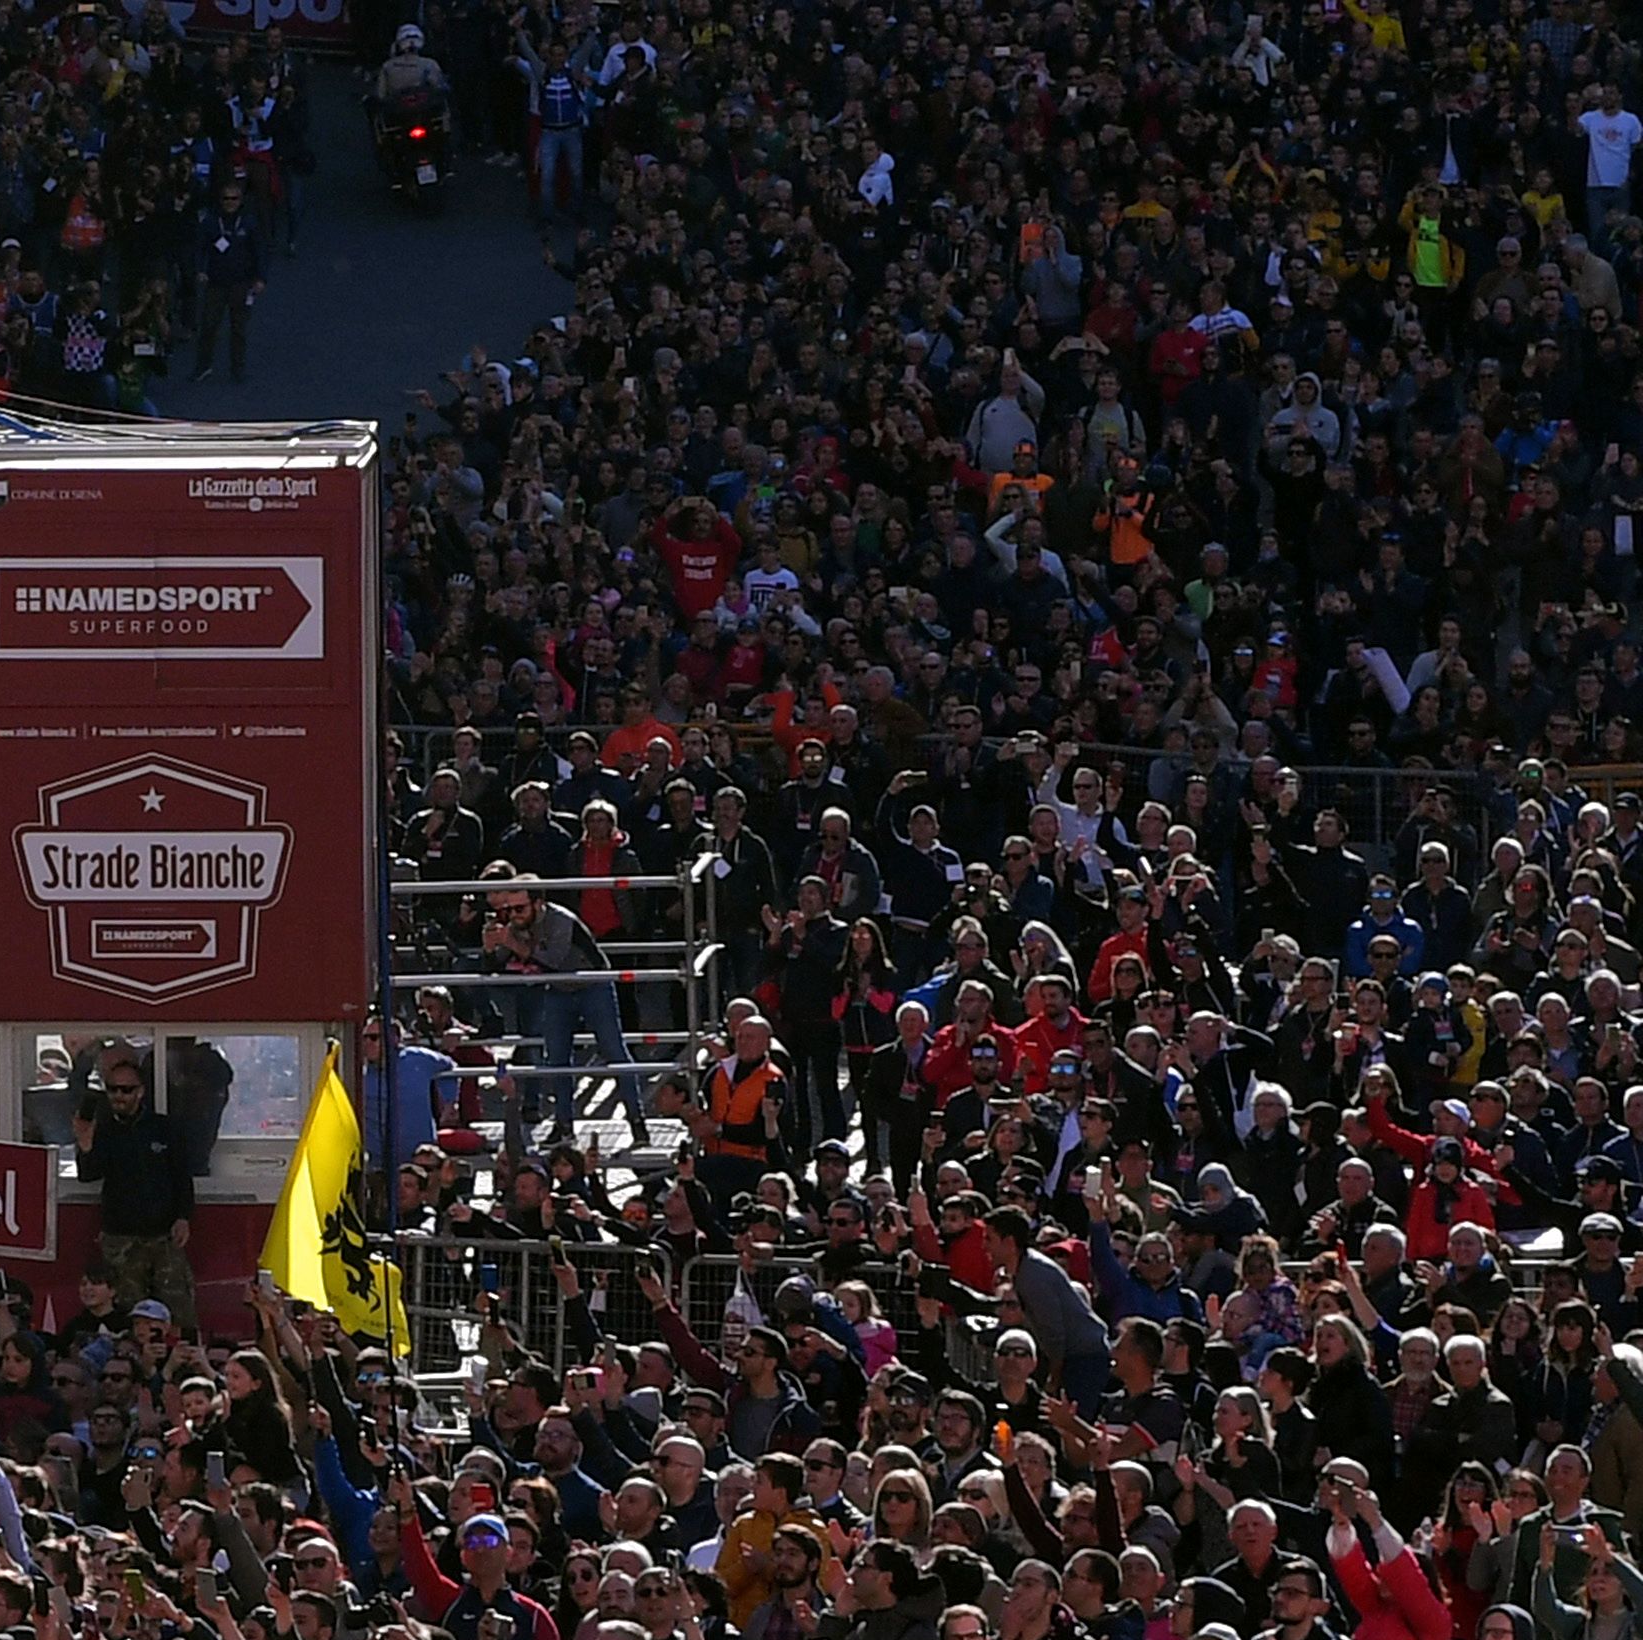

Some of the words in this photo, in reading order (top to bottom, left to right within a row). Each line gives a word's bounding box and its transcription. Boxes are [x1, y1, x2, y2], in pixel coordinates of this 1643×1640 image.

[11, 490, 56, 500] COMUNE
[59, 490, 69, 500] DI
[72, 490, 103, 500] SIENA
[189, 479, 202, 496] La
[204, 477, 253, 496] Gazzetta
[255, 477, 282, 496] dello
[284, 477, 317, 500] Sport
[46, 587, 261, 611] NAMEDSPORT
[69, 619, 210, 635] SUPERFOOD
[43, 844, 139, 888] Strade
[150, 844, 265, 888] Bianche
[113, 930, 194, 941] NAMEDSPORT
